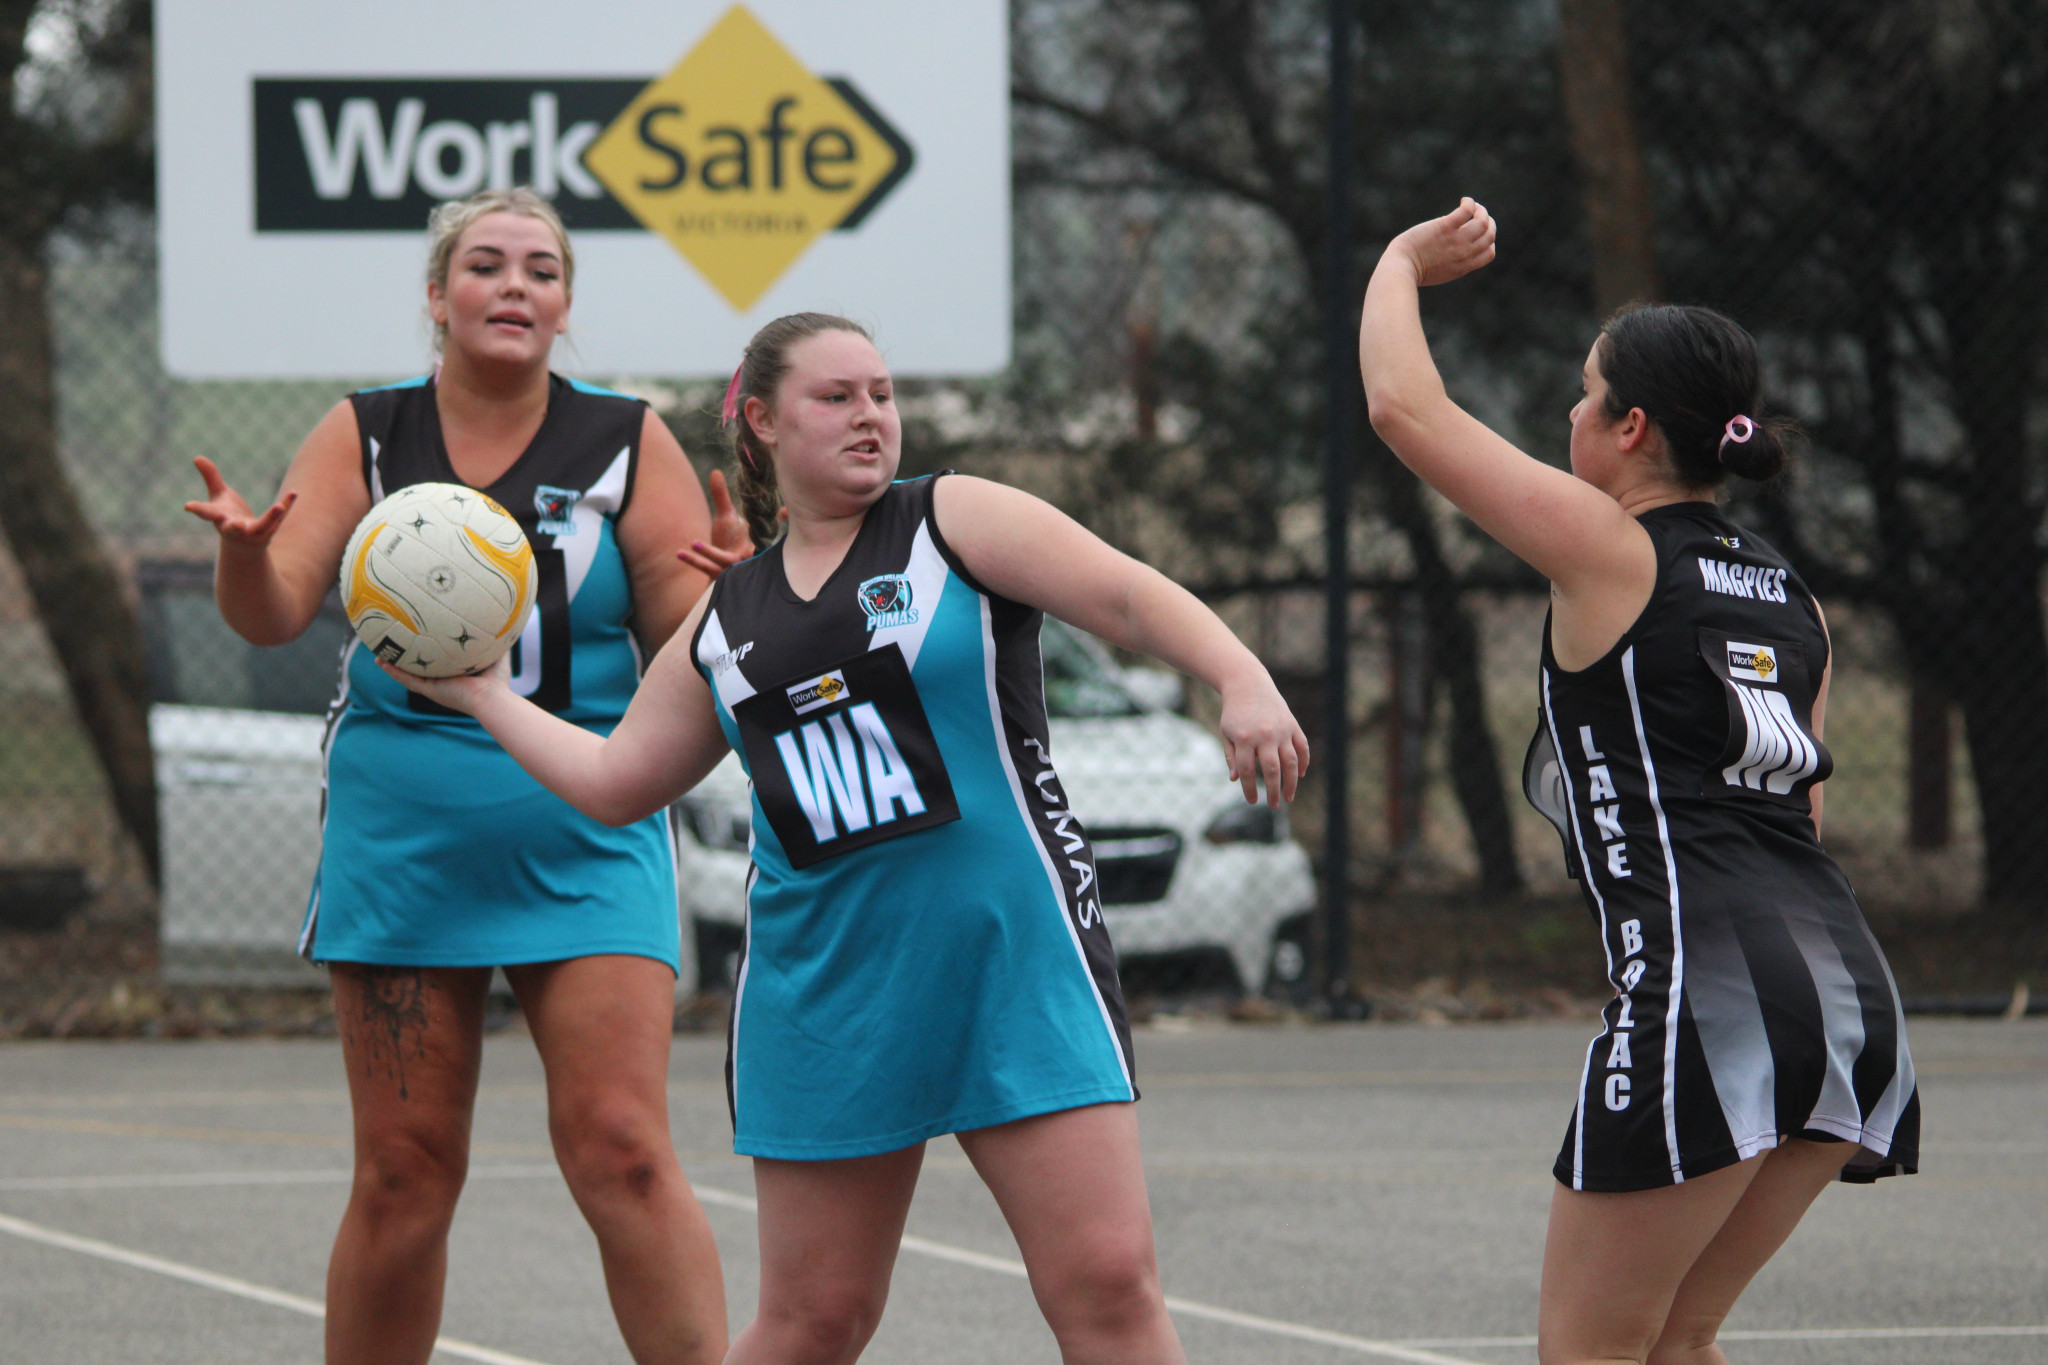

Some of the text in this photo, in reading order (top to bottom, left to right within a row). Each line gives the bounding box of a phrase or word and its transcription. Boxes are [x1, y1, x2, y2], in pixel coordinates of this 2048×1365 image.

[293, 91, 859, 199] Work Safe
[866, 608, 919, 632] PUMAS
[1697, 556, 1787, 604] MAGPIES
[774, 701, 928, 845] WA
[1023, 736, 1101, 930] PUMAS
[1578, 725, 1646, 1112] LAKE BOLAC
